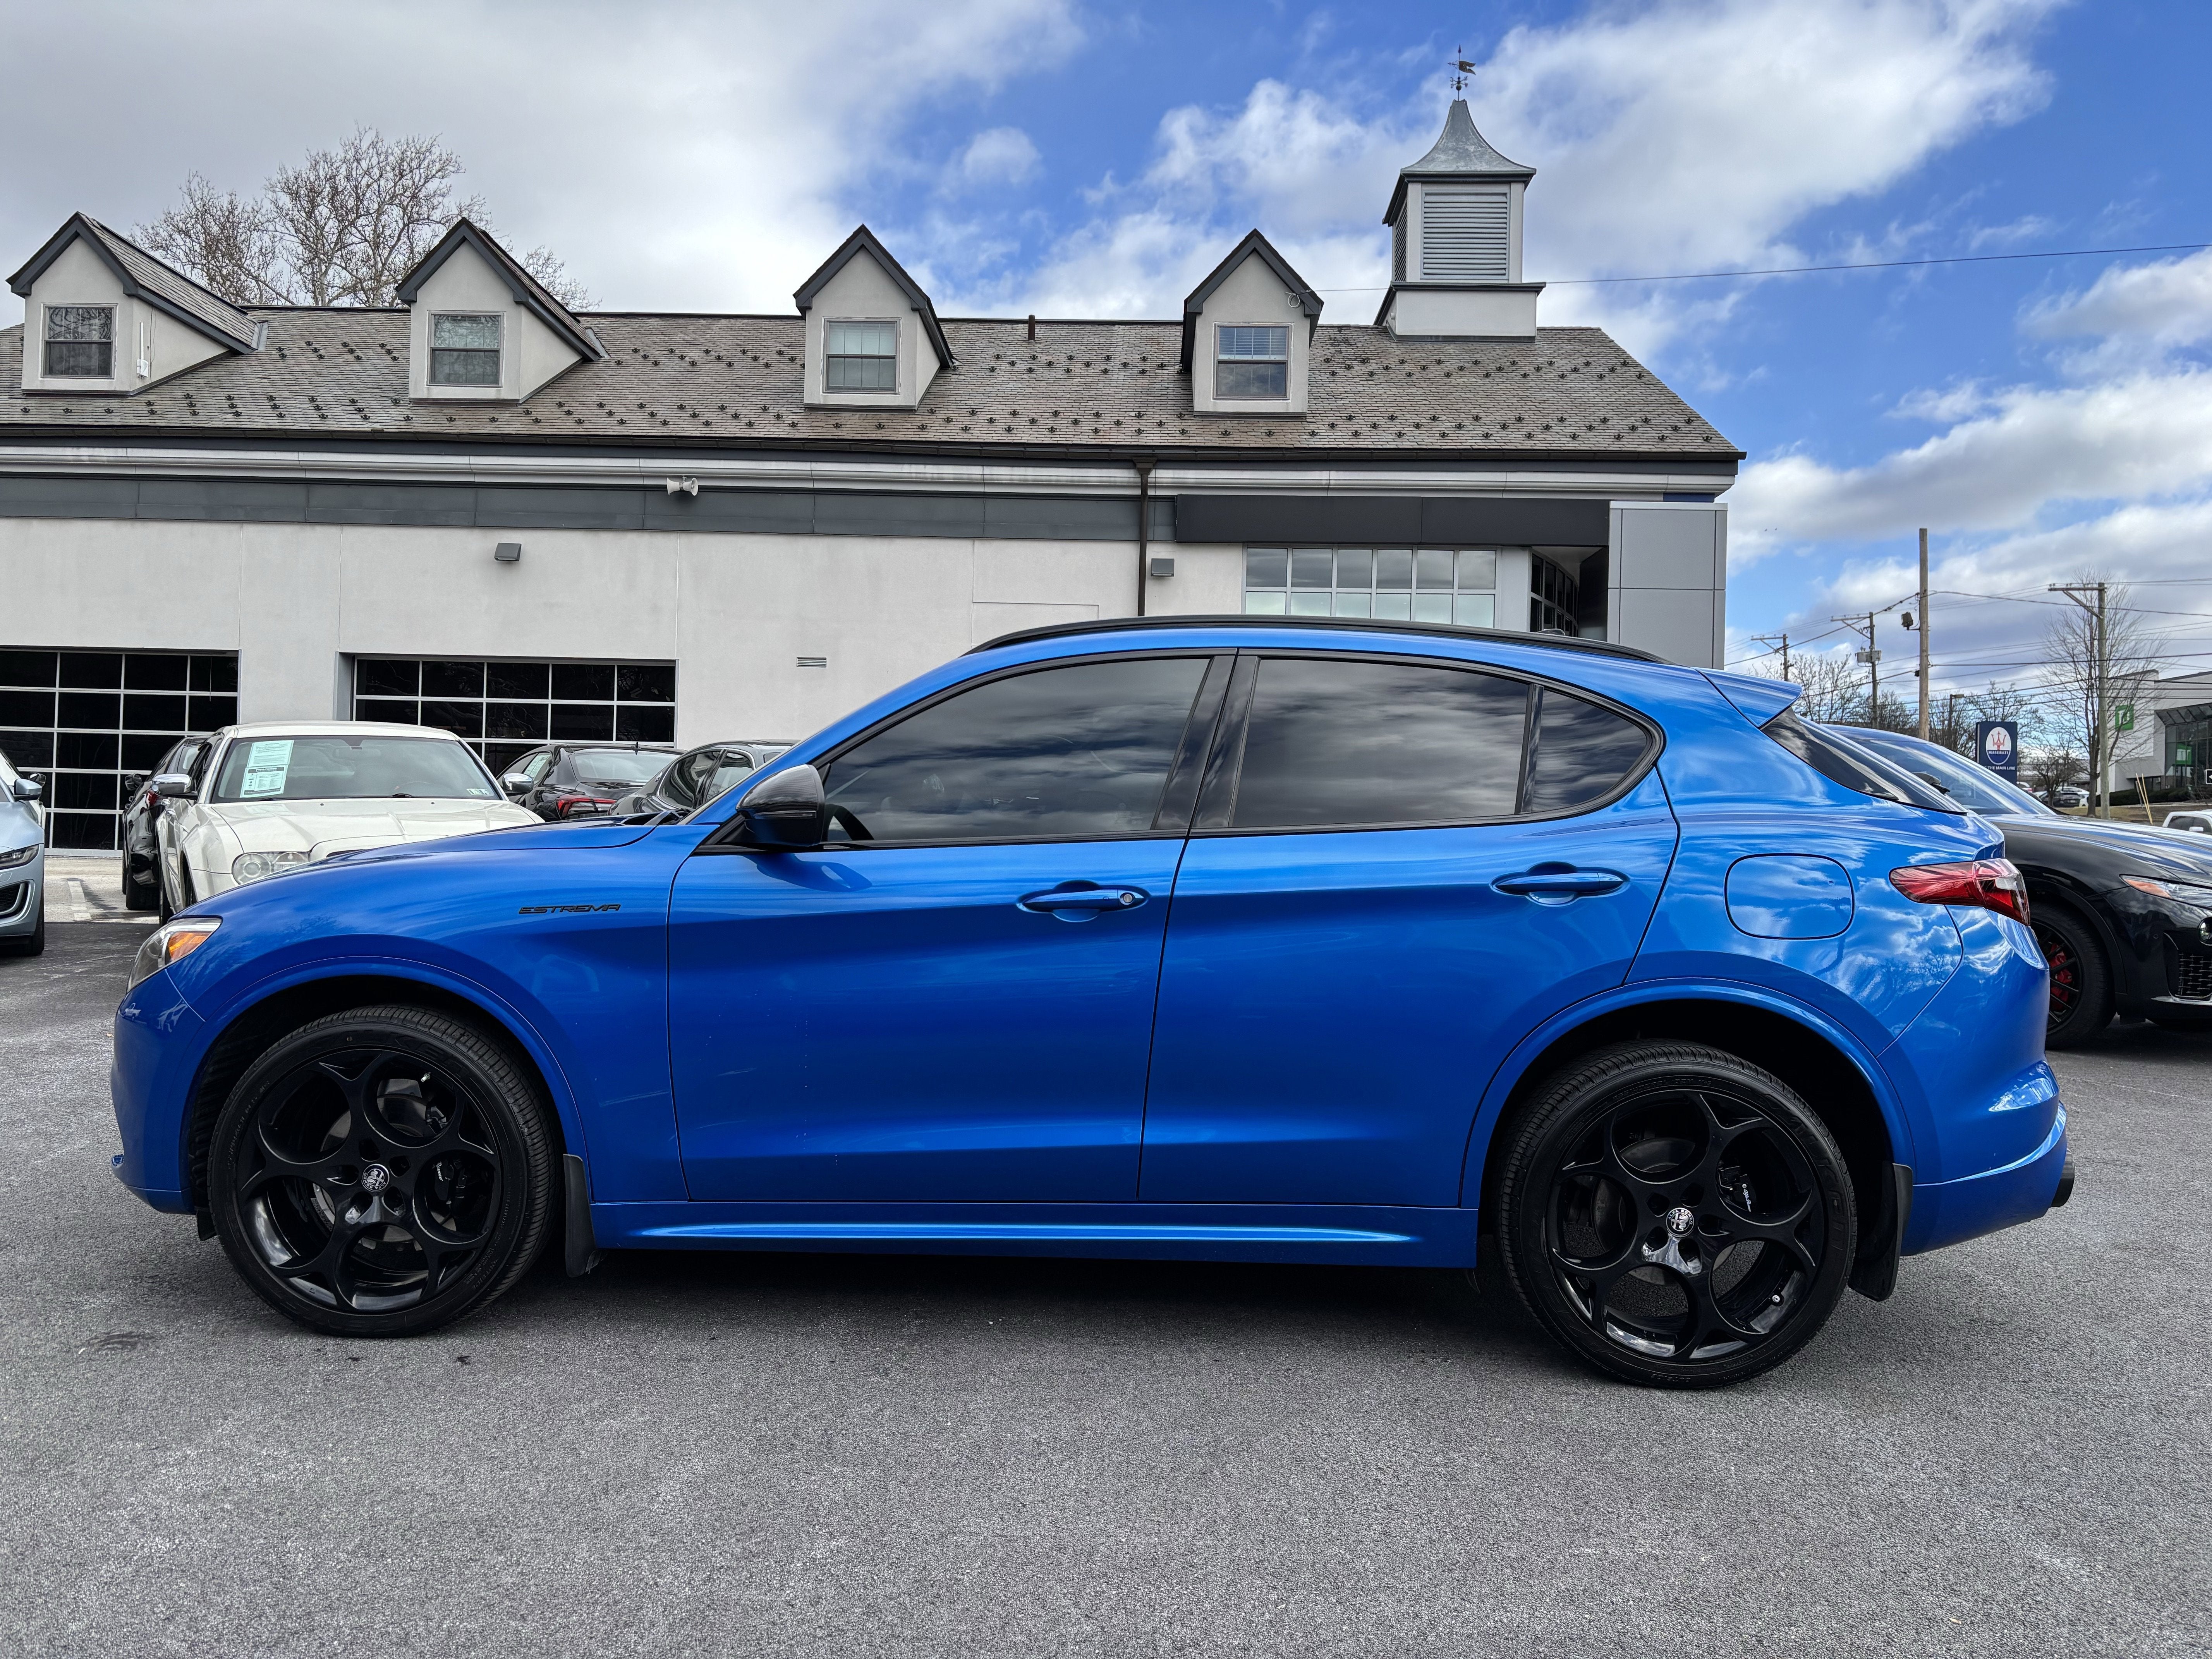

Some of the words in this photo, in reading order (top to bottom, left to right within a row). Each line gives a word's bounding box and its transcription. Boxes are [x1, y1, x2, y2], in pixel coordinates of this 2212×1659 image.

[519, 904, 621, 914] ESTREMA
[364, 1172, 373, 1189] ROMEO
[375, 1182, 386, 1190] ALFA
[1668, 1209, 1679, 1220] ALFA
[1681, 1209, 1693, 1225] ROMEO
